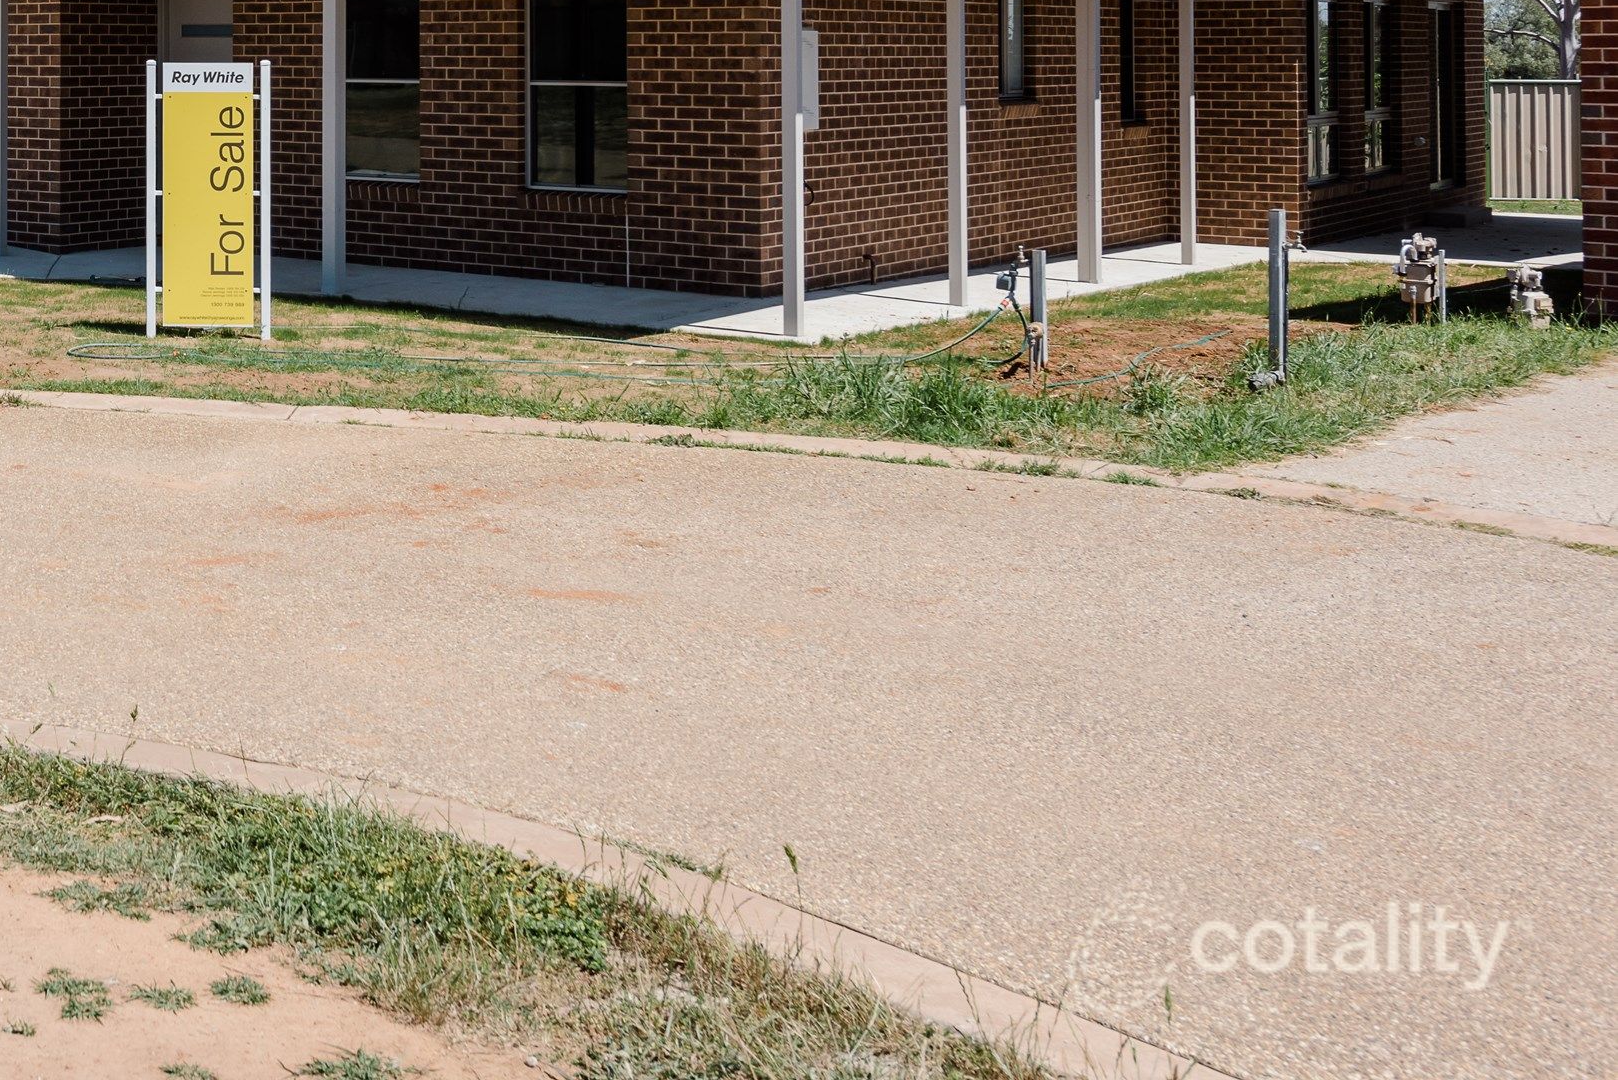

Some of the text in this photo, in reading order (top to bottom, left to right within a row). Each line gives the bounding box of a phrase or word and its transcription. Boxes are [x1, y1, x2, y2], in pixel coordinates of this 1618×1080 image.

[172, 71, 244, 85] Ray White
[210, 106, 245, 192] Sale
[210, 214, 245, 276] For
